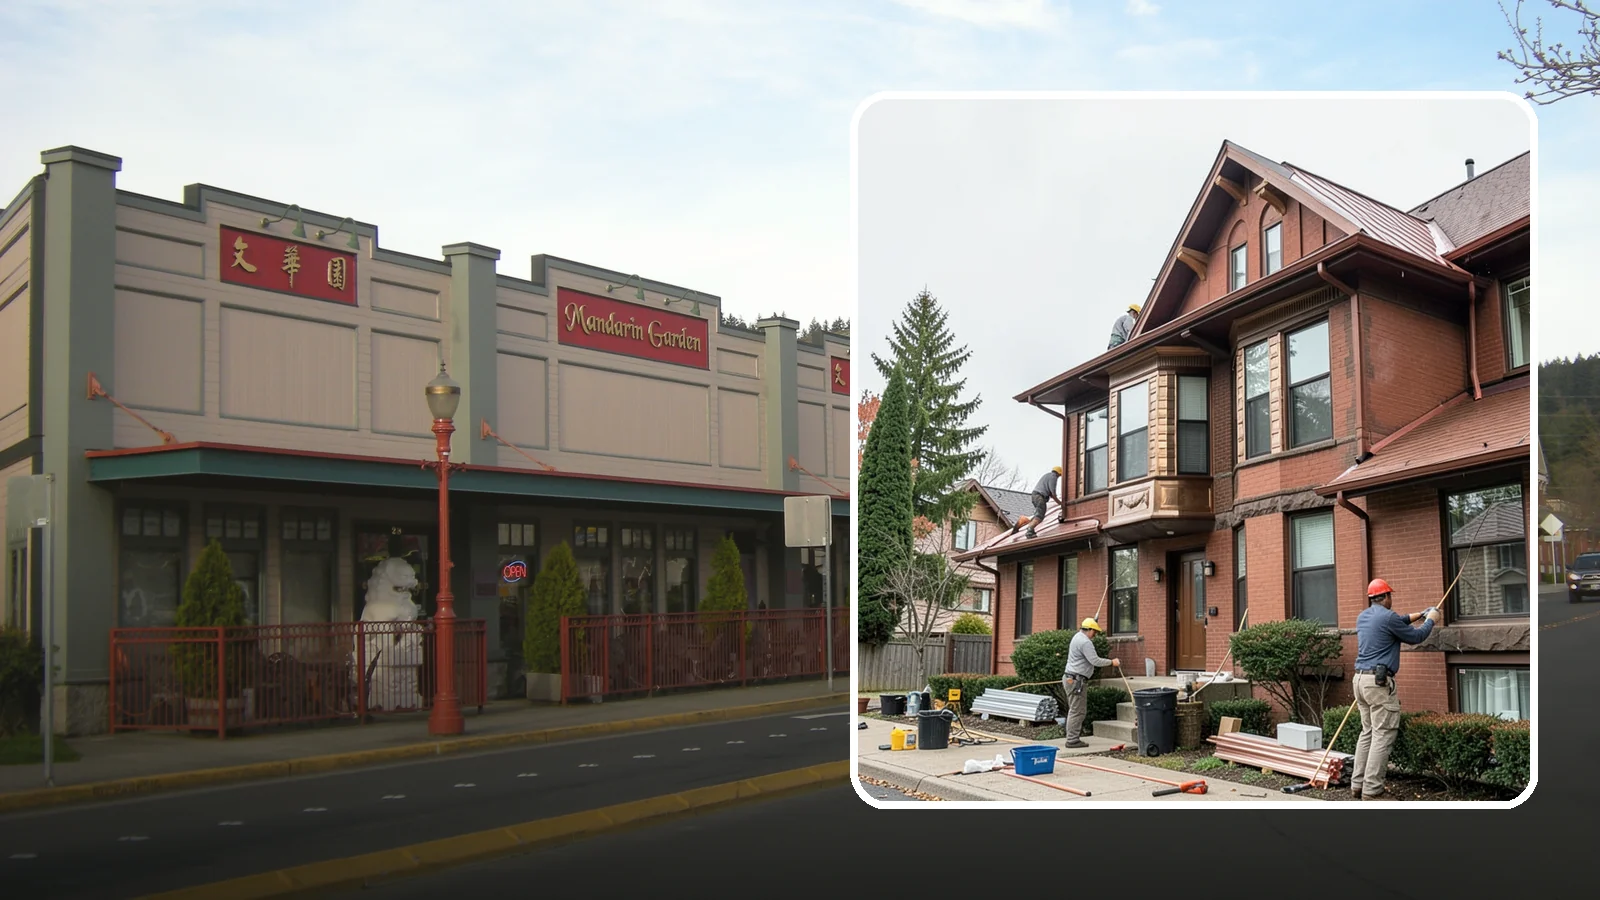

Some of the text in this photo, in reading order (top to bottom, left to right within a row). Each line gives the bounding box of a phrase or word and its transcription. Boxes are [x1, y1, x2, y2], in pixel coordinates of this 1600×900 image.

[231, 236, 346, 291] 文華園
[565, 302, 702, 352] Mandarin Garden
[503, 565, 527, 578] OPEN
